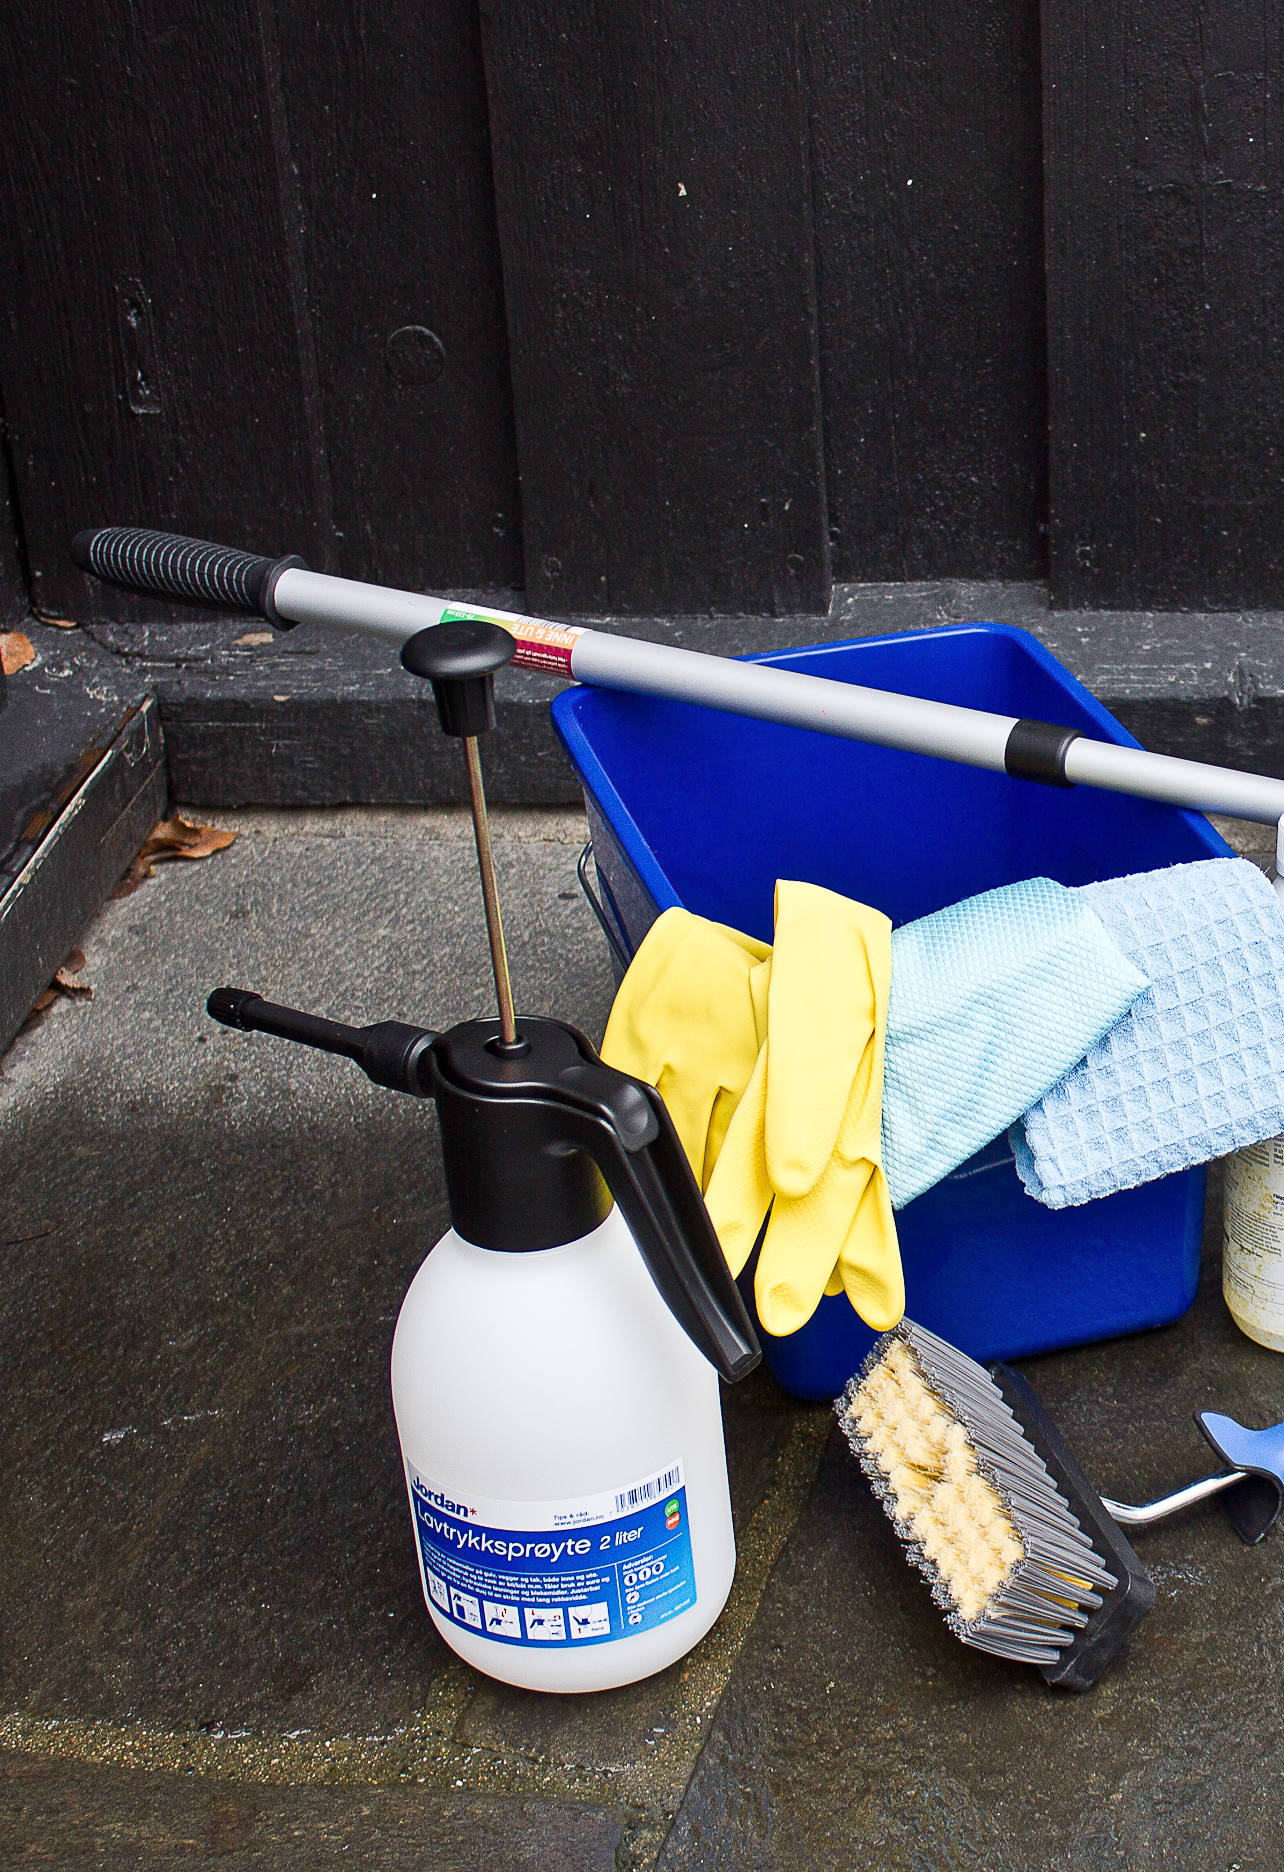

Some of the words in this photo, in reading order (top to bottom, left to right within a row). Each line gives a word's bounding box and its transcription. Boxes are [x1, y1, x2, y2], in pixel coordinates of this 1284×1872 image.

[511, 623, 535, 637] UTE
[545, 631, 575, 645] INNE
[417, 1500, 592, 1563] Lavtrykksprøyte
[599, 1535, 611, 1551] 2
[614, 1526, 645, 1547] liter
